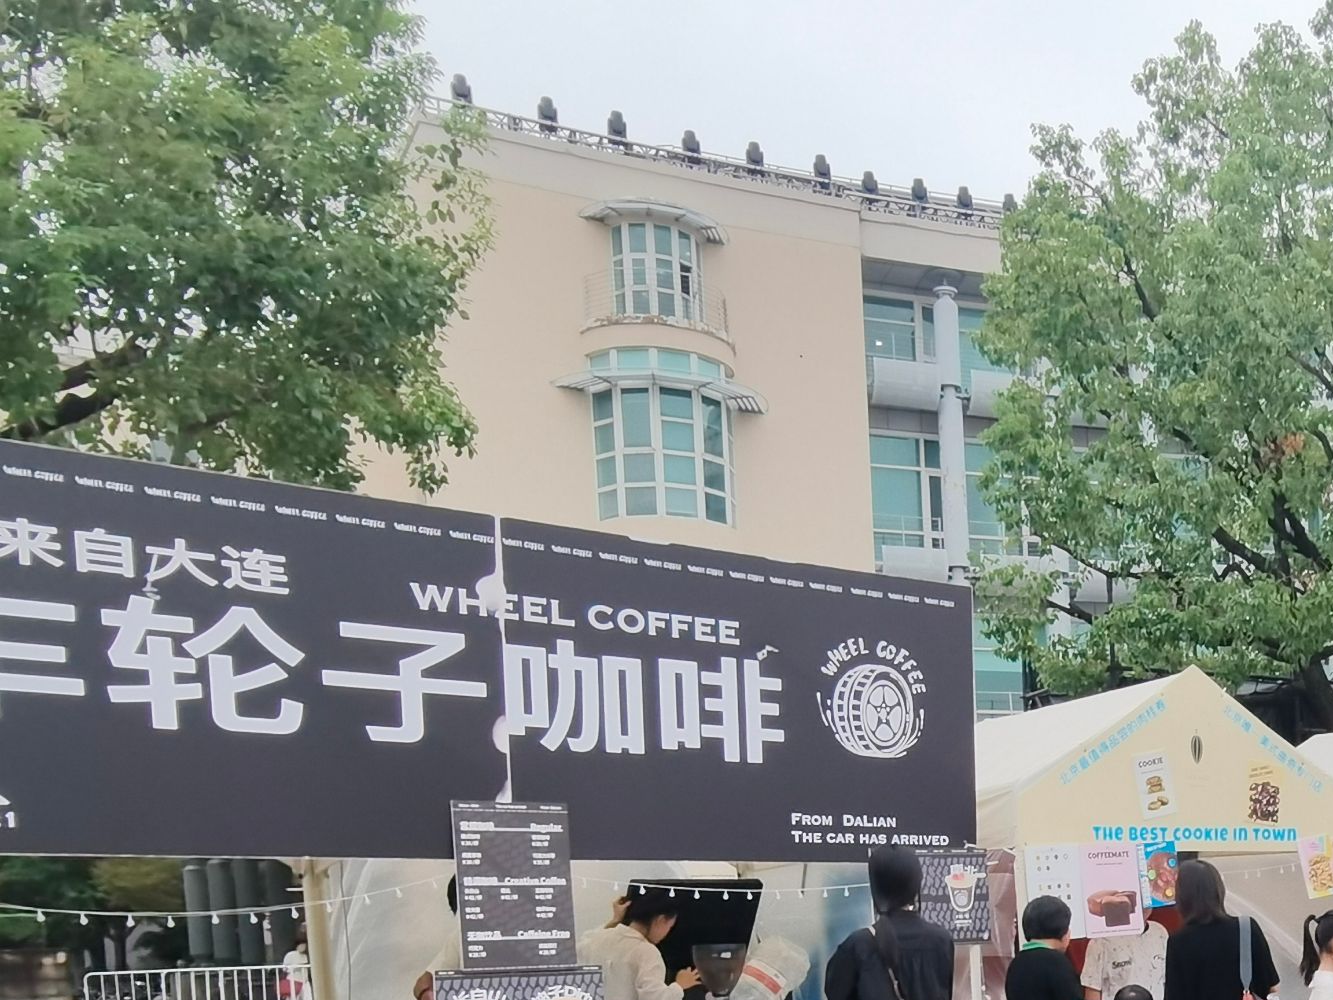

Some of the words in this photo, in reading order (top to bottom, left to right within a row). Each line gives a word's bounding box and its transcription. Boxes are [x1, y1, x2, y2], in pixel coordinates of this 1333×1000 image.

[0, 518, 290, 595] 来自大连
[409, 582, 576, 627] WHEEL
[588, 604, 740, 646] COFFEE
[821, 637, 869, 677] WHEEL
[876, 640, 927, 695] COFFEE
[1138, 757, 1164, 768] COOKIE
[791, 812, 833, 826] FROM
[791, 830, 822, 843] THE
[826, 833, 855, 844] CAR
[859, 834, 887, 845] HAS
[891, 834, 949, 846] ARRIVED
